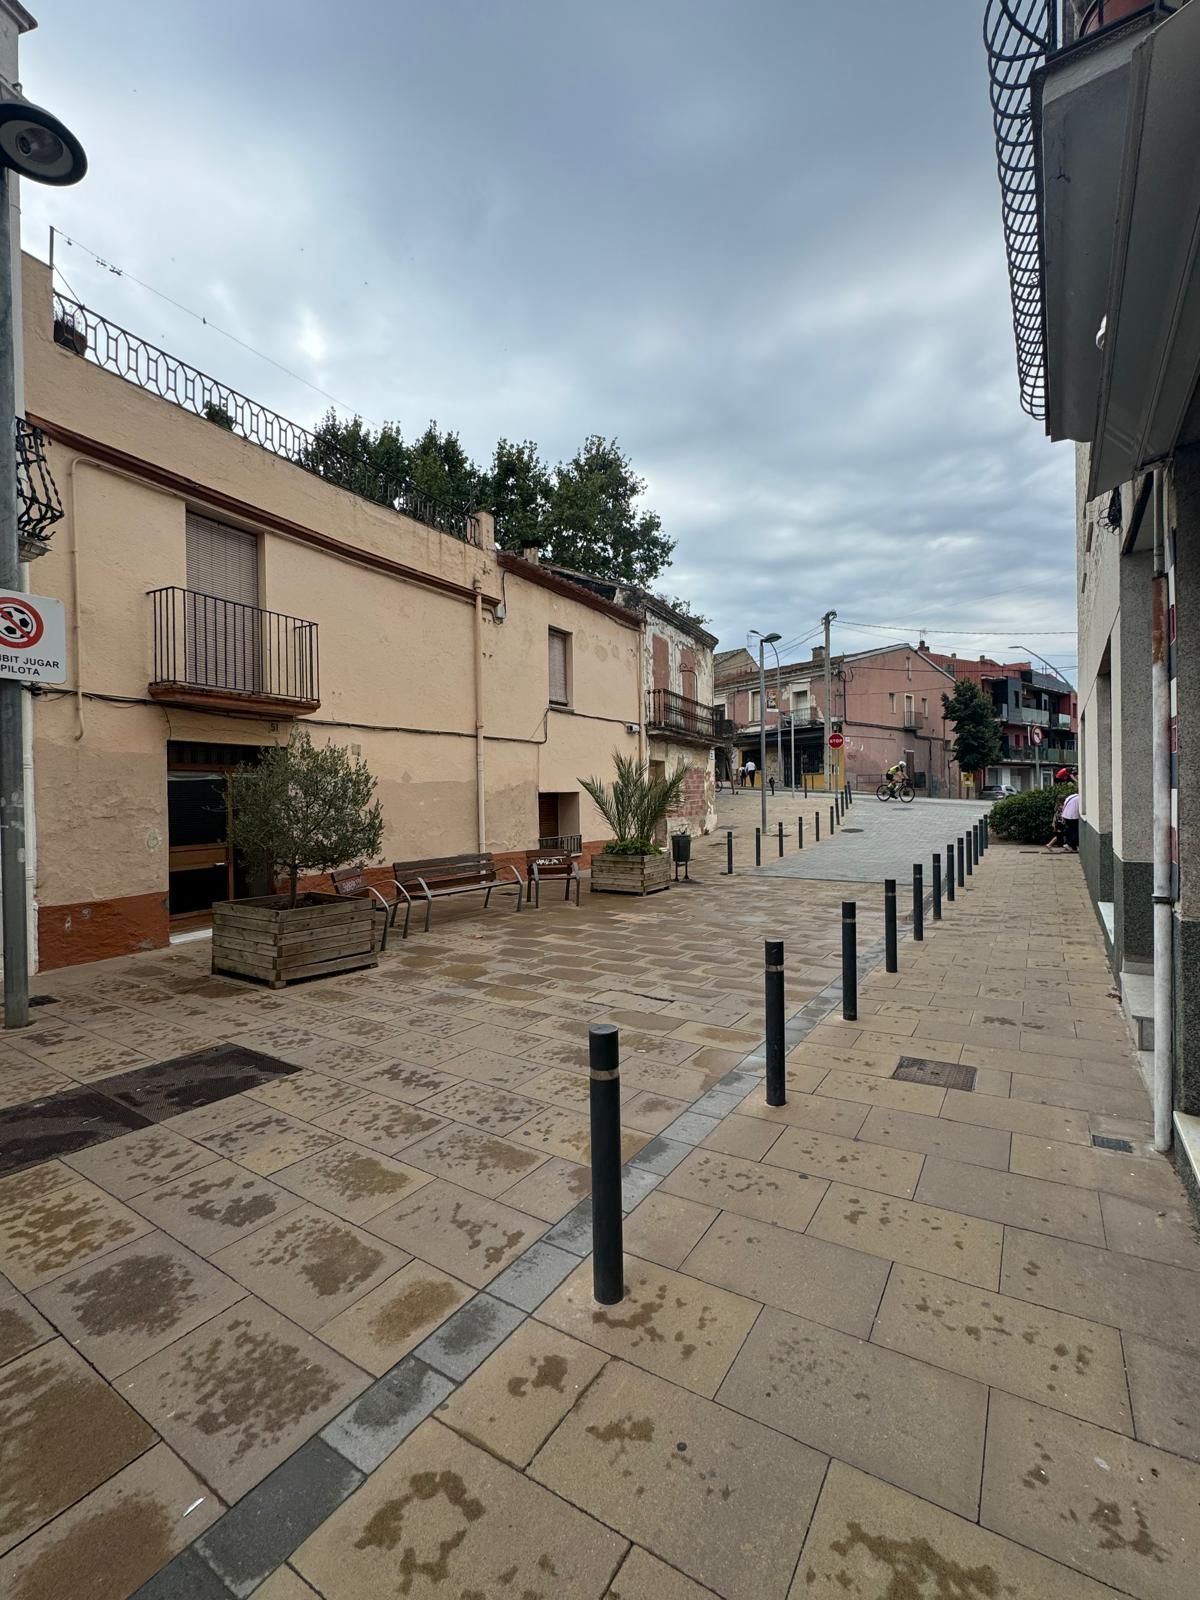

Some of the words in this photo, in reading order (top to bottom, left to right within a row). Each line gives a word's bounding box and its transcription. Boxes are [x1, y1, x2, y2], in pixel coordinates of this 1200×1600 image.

[23, 658, 60, 669] JUGAR
[0, 664, 40, 676] PILOTA
[271, 722, 278, 731] 51
